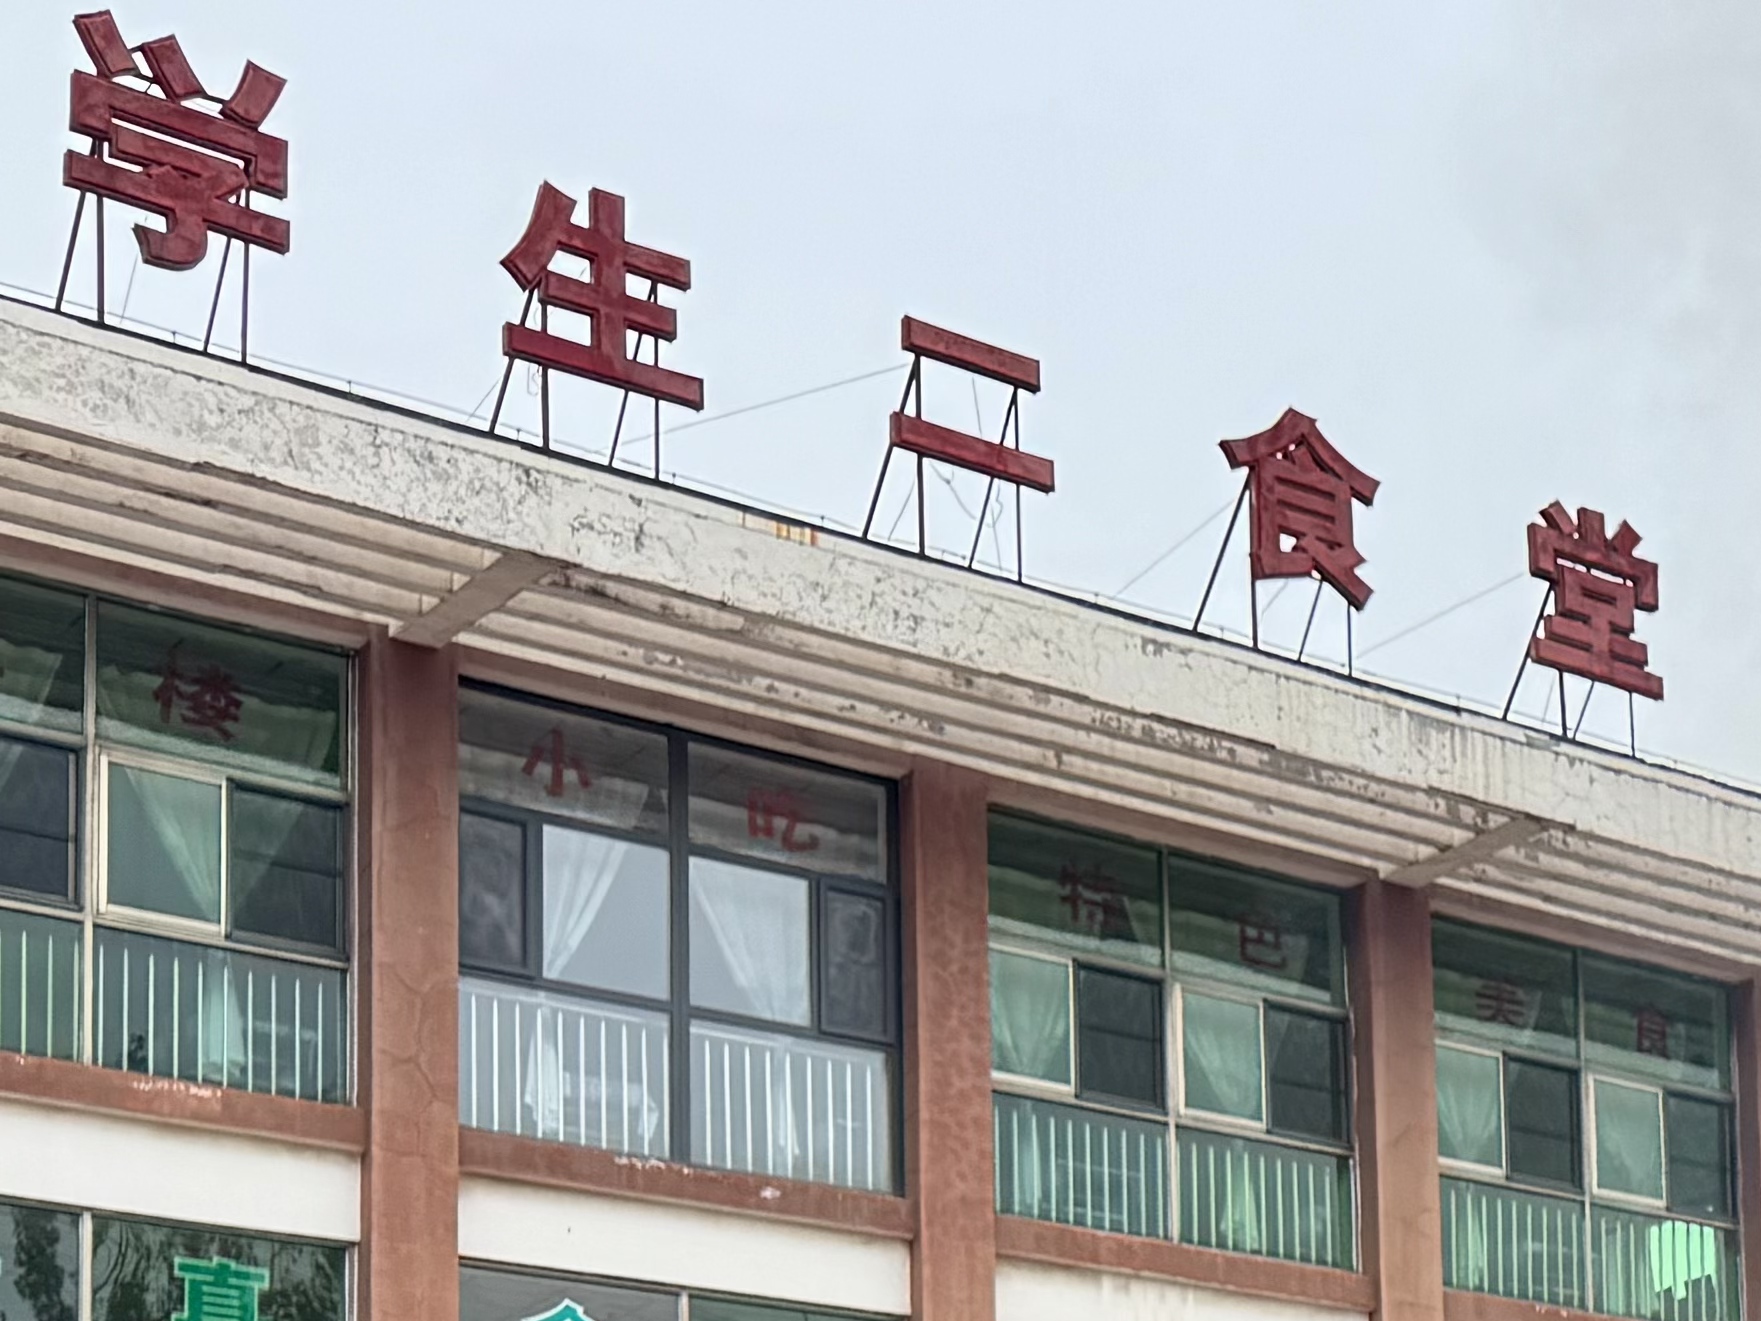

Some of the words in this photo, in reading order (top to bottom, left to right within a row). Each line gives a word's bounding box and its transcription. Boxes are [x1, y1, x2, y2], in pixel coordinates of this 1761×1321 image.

[62, 9, 1665, 702] 学生二食堂
[152, 640, 246, 742] 楼
